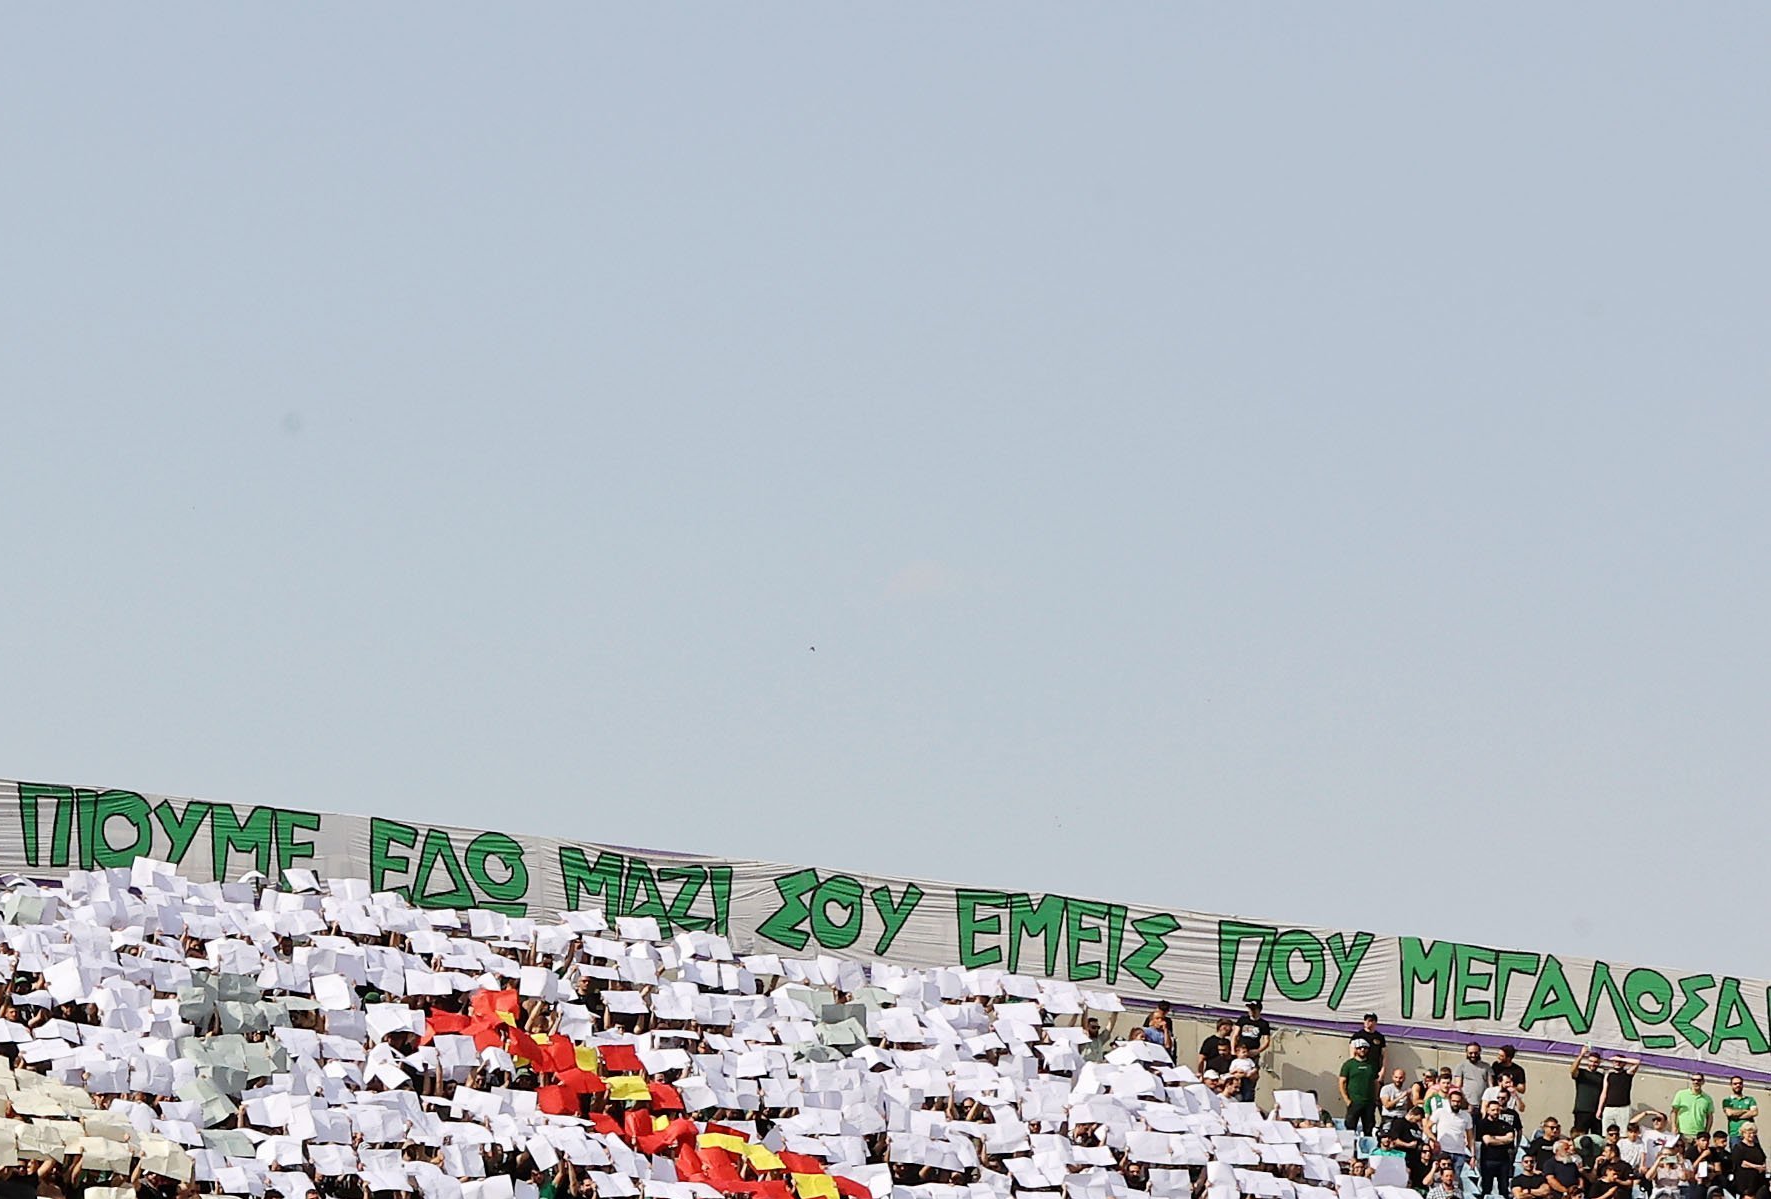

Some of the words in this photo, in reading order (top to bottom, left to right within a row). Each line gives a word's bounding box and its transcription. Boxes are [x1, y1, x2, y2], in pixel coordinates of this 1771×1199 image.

[17, 782, 321, 888] ΠΙΟΥΜΕ
[559, 847, 734, 938] ΜΑΖΙ
[755, 868, 924, 956] ΣΟΥ
[955, 888, 1182, 989] ΕΜΕΙΣ
[1218, 920, 1374, 1011] ΠΟΥ
[1399, 936, 1771, 1055] ΜΕΓΑΛΩΣΑ
